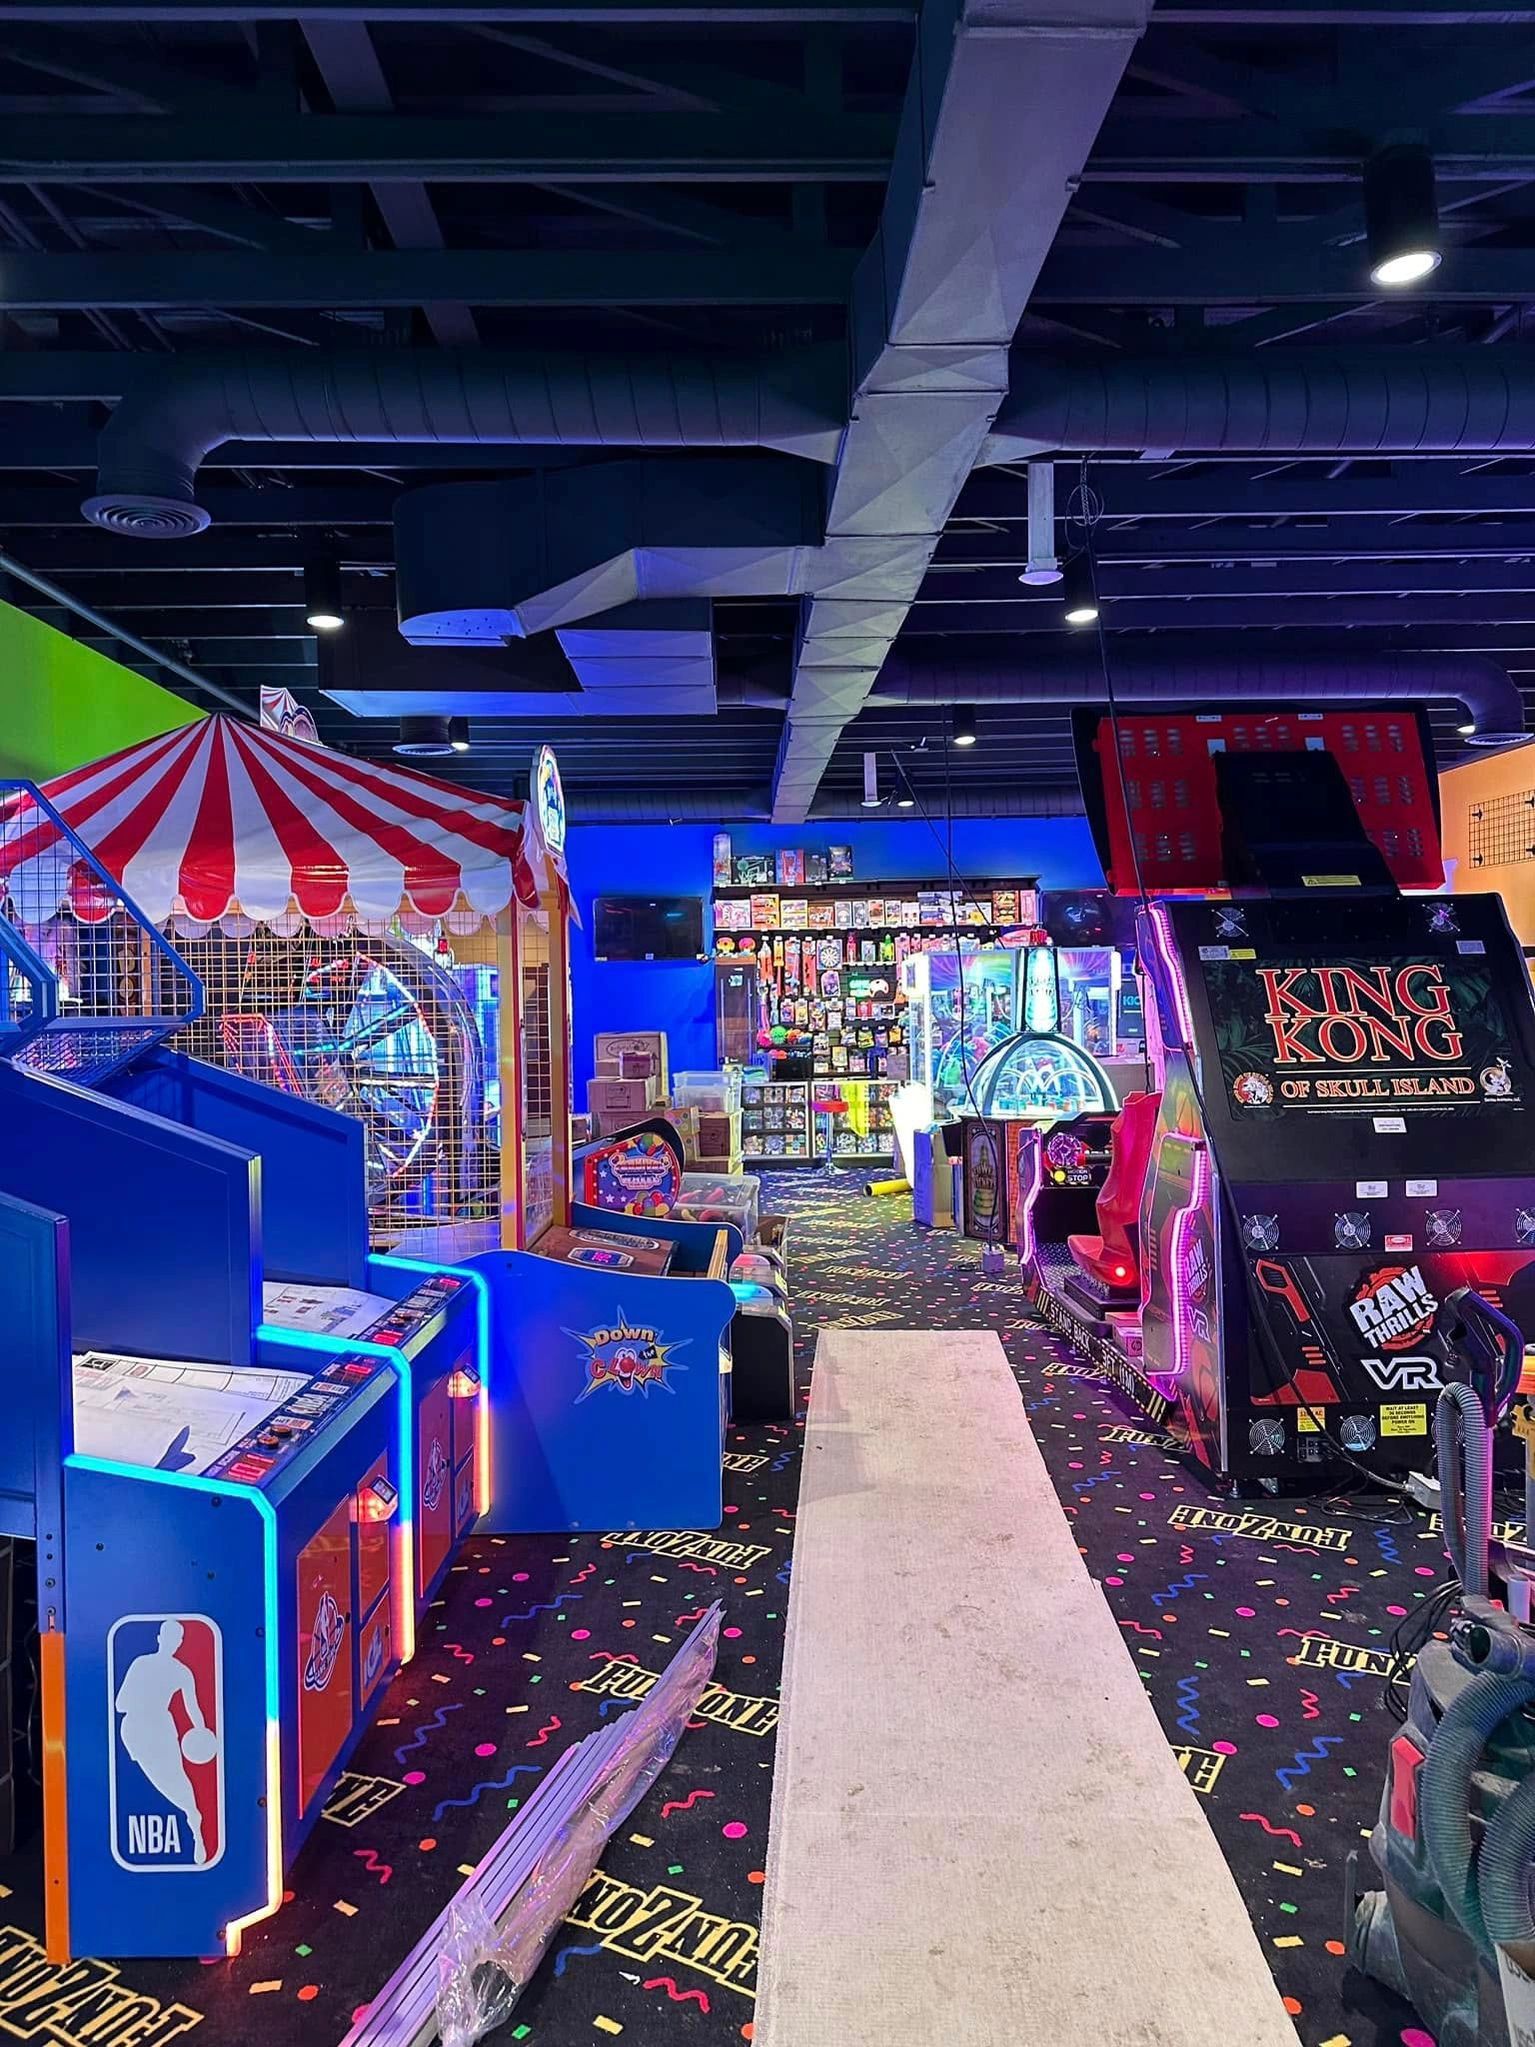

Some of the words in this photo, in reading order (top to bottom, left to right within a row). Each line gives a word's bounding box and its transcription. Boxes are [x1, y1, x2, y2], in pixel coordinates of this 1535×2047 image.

[1256, 964, 1450, 1017] KING
[1265, 1014, 1463, 1063] KONG
[1280, 1079, 1310, 1098] OF
[1315, 1079, 1390, 1098] SKULL
[1393, 1076, 1475, 1097] ISLAND
[1067, 1174, 1089, 1182] STOP
[1349, 1265, 1427, 1333] RAW
[594, 1328, 655, 1346] Down
[1187, 1304, 1211, 1343] VR
[1363, 1293, 1438, 1348] THRILLS
[1361, 1356, 1445, 1390] VR
[128, 1814, 181, 1854] NBA
